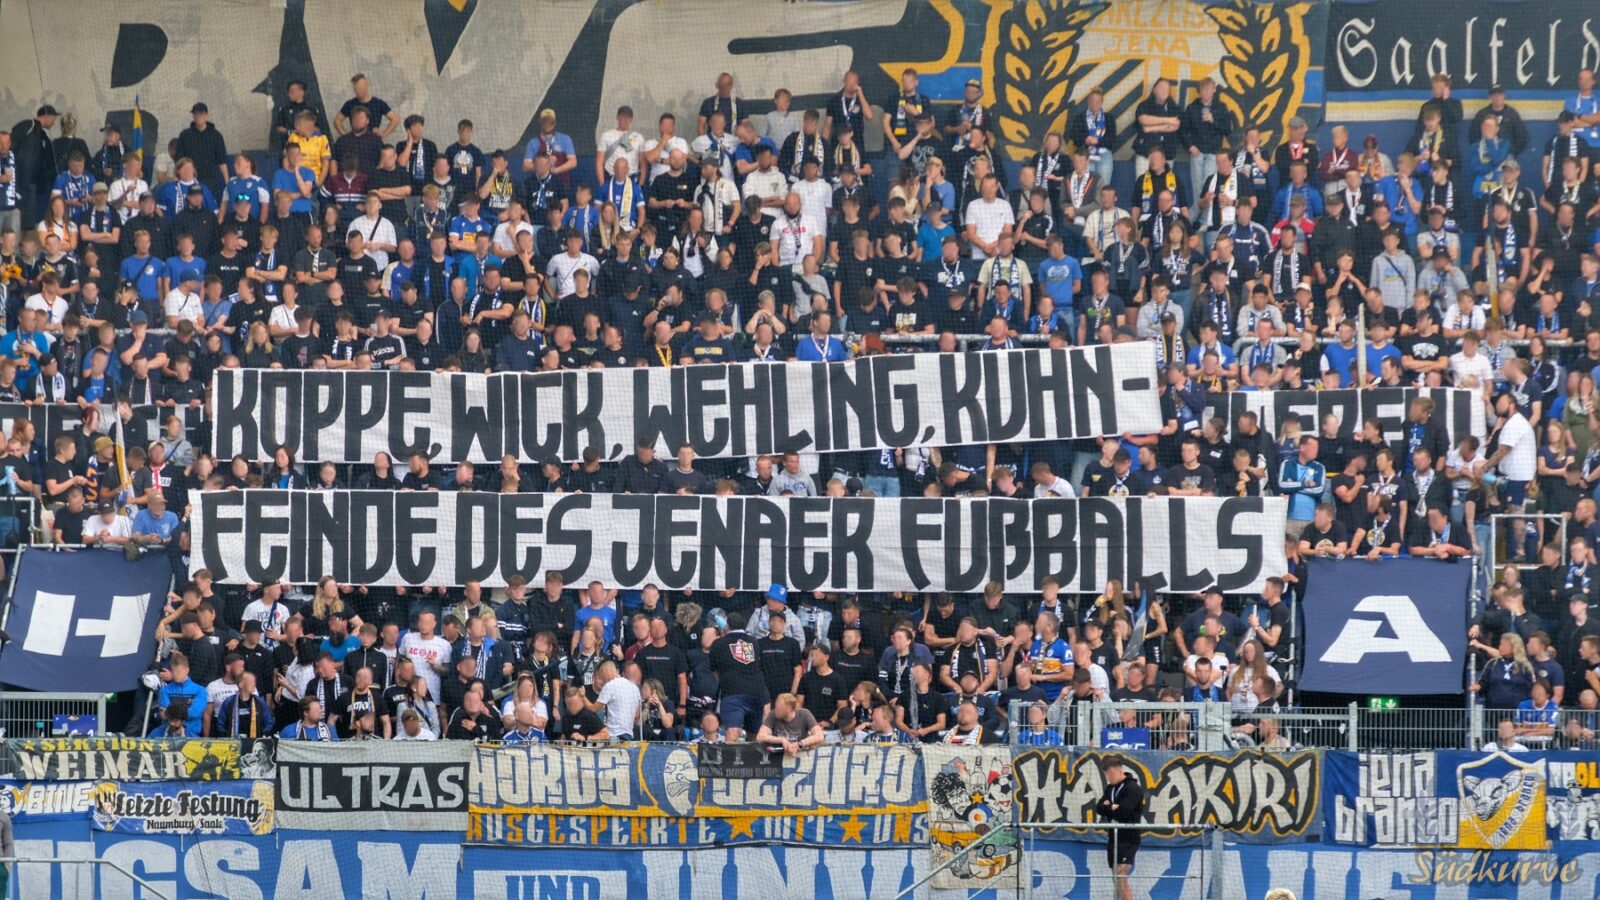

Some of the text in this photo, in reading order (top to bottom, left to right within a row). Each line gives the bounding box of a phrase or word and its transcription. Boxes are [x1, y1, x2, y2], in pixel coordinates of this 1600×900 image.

[1104, 34, 1191, 57] JENA
[1336, 17, 1600, 88] Saalfeld
[216, 370, 442, 462] KOPPE,
[451, 372, 623, 462] WICK,
[633, 355, 935, 460] WEHLING,
[939, 345, 1150, 443] KUHN-
[201, 491, 438, 585] FEINDE
[455, 493, 592, 586] DES
[611, 494, 875, 590] JENAER
[23, 590, 151, 658] H
[1319, 595, 1452, 663] A
[17, 751, 190, 780] WEIMAR
[40, 738, 155, 751] SEKTION
[114, 790, 262, 823] Letzte Festung
[279, 766, 464, 809] ULTRAS
[1018, 755, 1313, 829] HAAKIRI
[466, 812, 929, 846] AUSGESPERRTE MIT UNS
